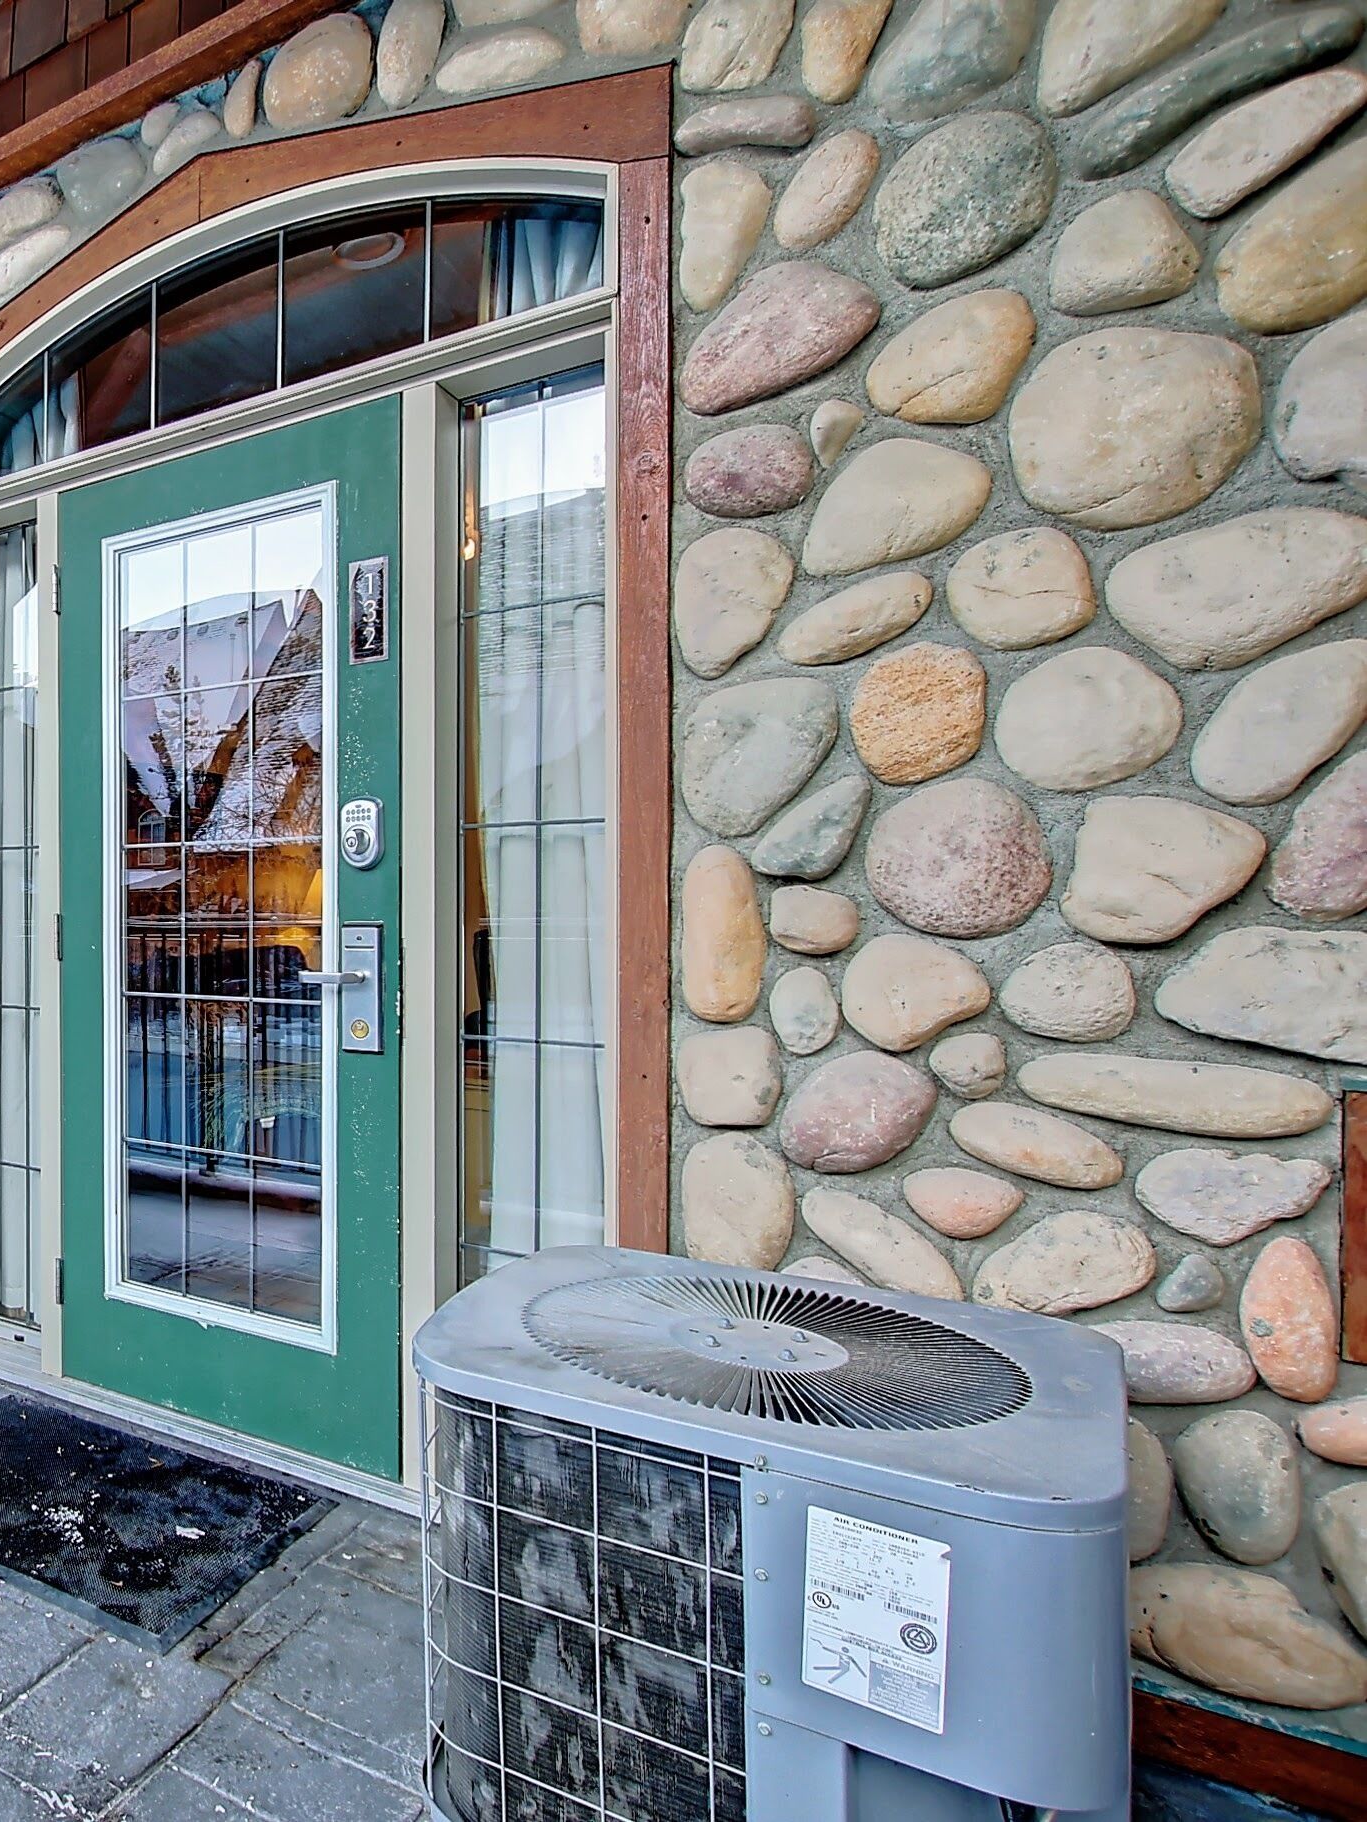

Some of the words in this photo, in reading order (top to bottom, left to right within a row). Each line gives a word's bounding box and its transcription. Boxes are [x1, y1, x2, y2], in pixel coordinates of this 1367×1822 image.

[362, 572, 377, 650] 132
[834, 1516, 850, 1525] AIR
[852, 1522, 918, 1545] CONDITIONER
[893, 1660, 935, 1680] WARNING
